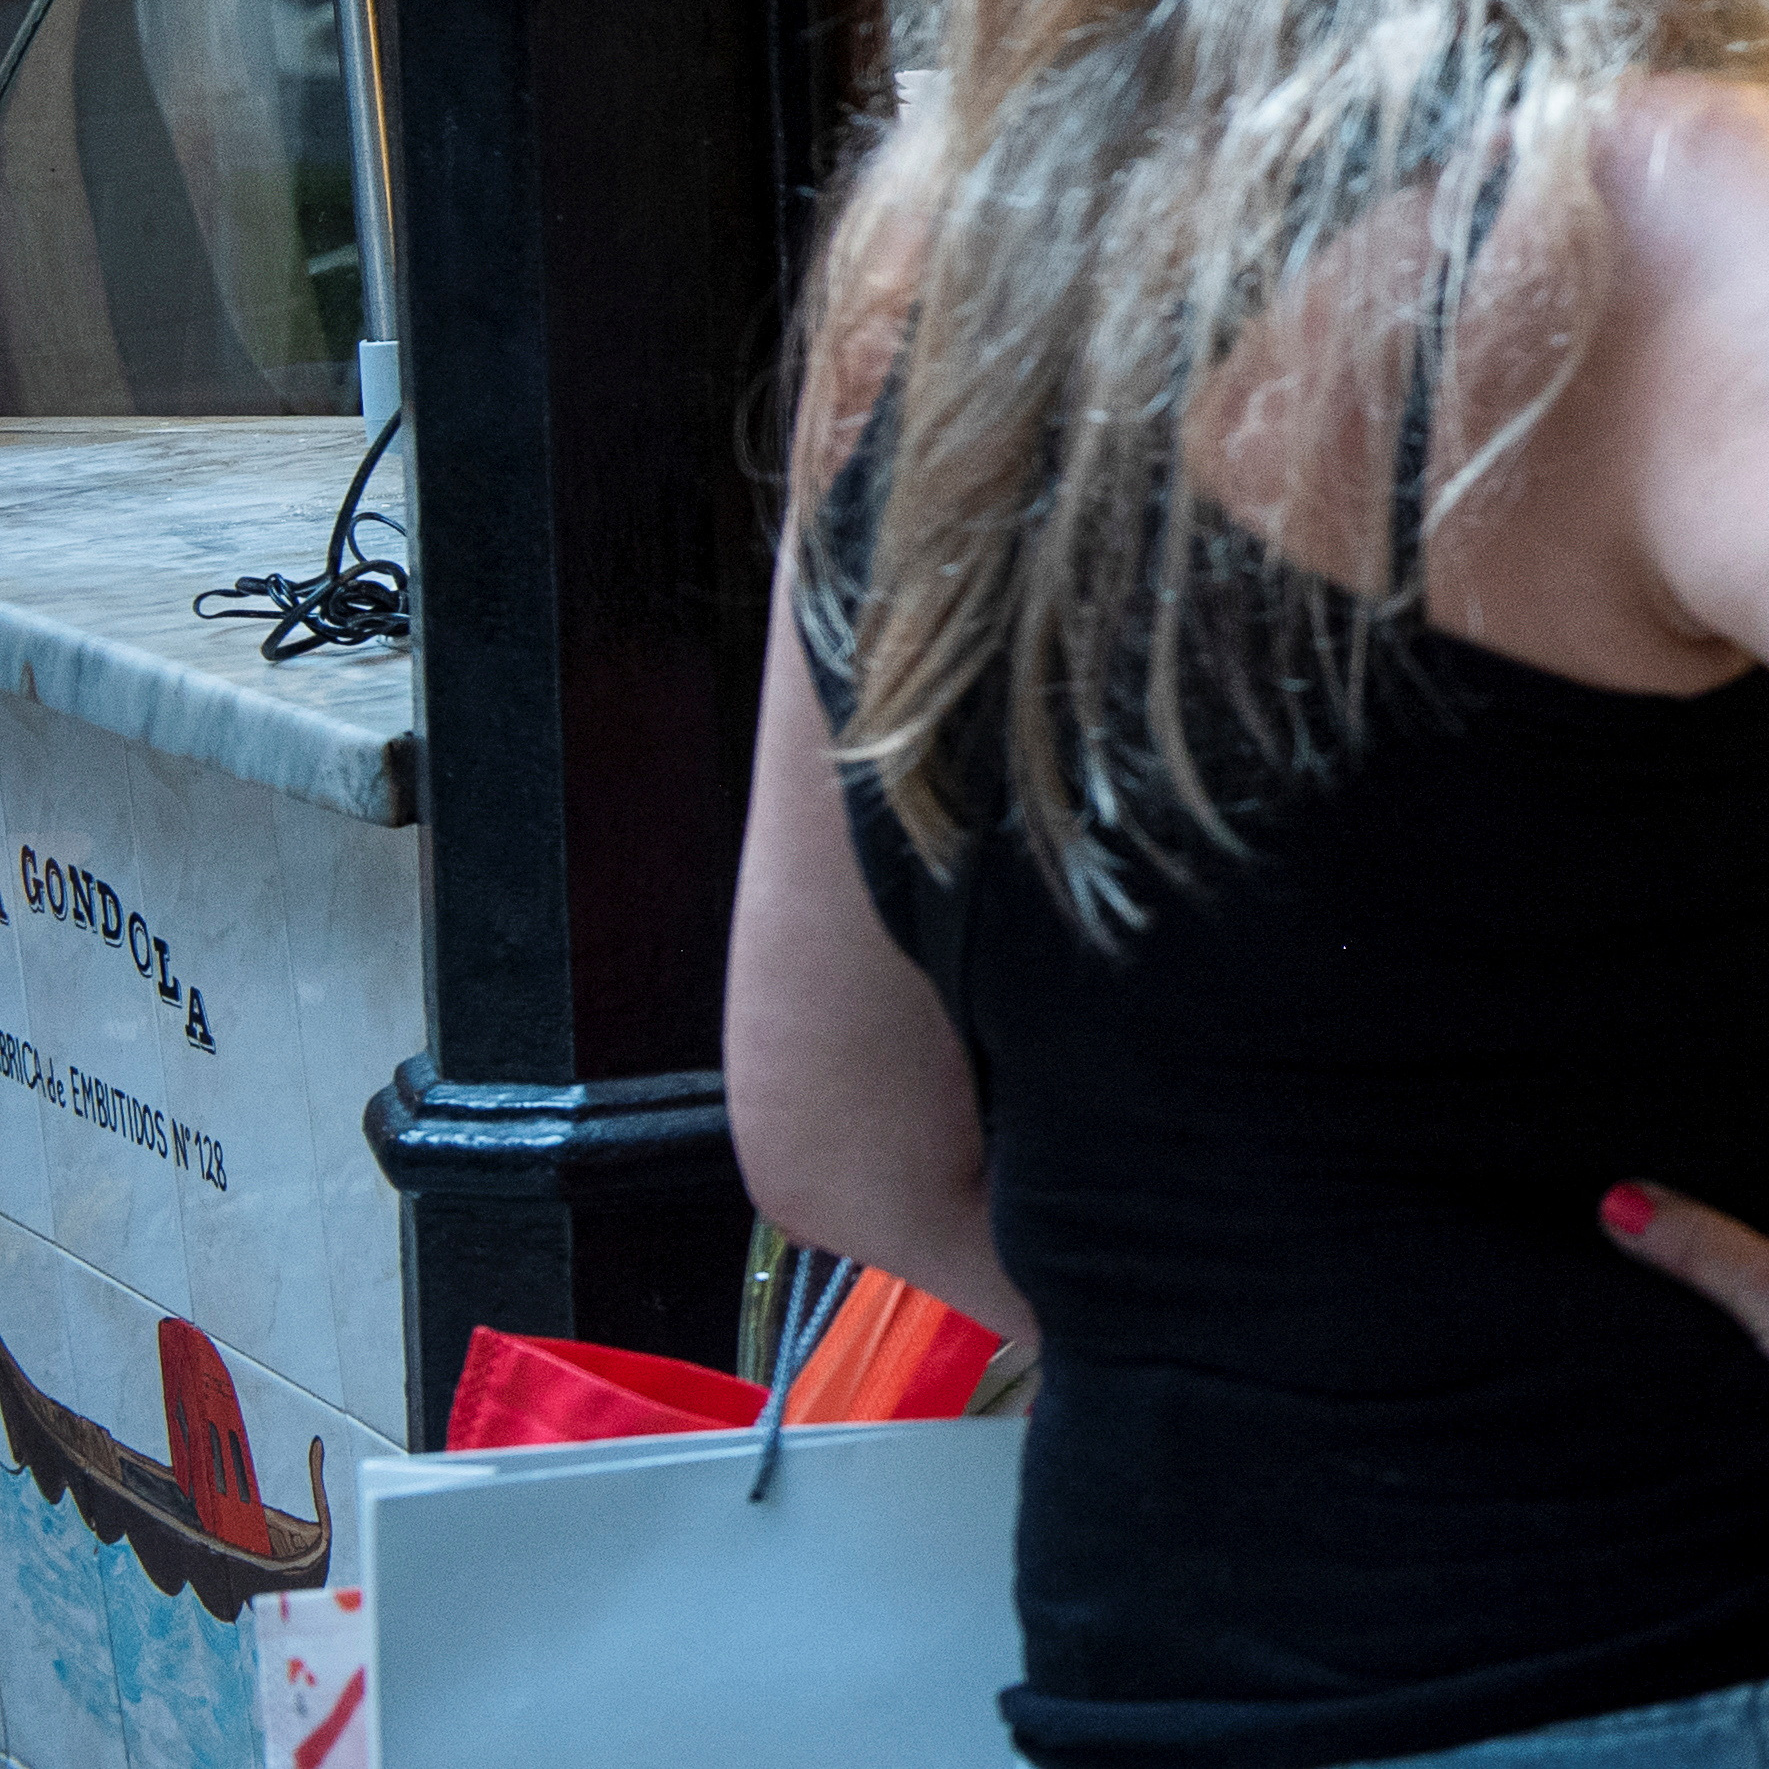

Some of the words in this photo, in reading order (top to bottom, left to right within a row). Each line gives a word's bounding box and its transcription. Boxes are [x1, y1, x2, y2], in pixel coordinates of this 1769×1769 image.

[20, 844, 217, 1055] GONDOLA
[46, 1057, 66, 1108] de
[69, 1066, 168, 1159] EMBUTIDOS
[194, 1130, 228, 1193] 128
